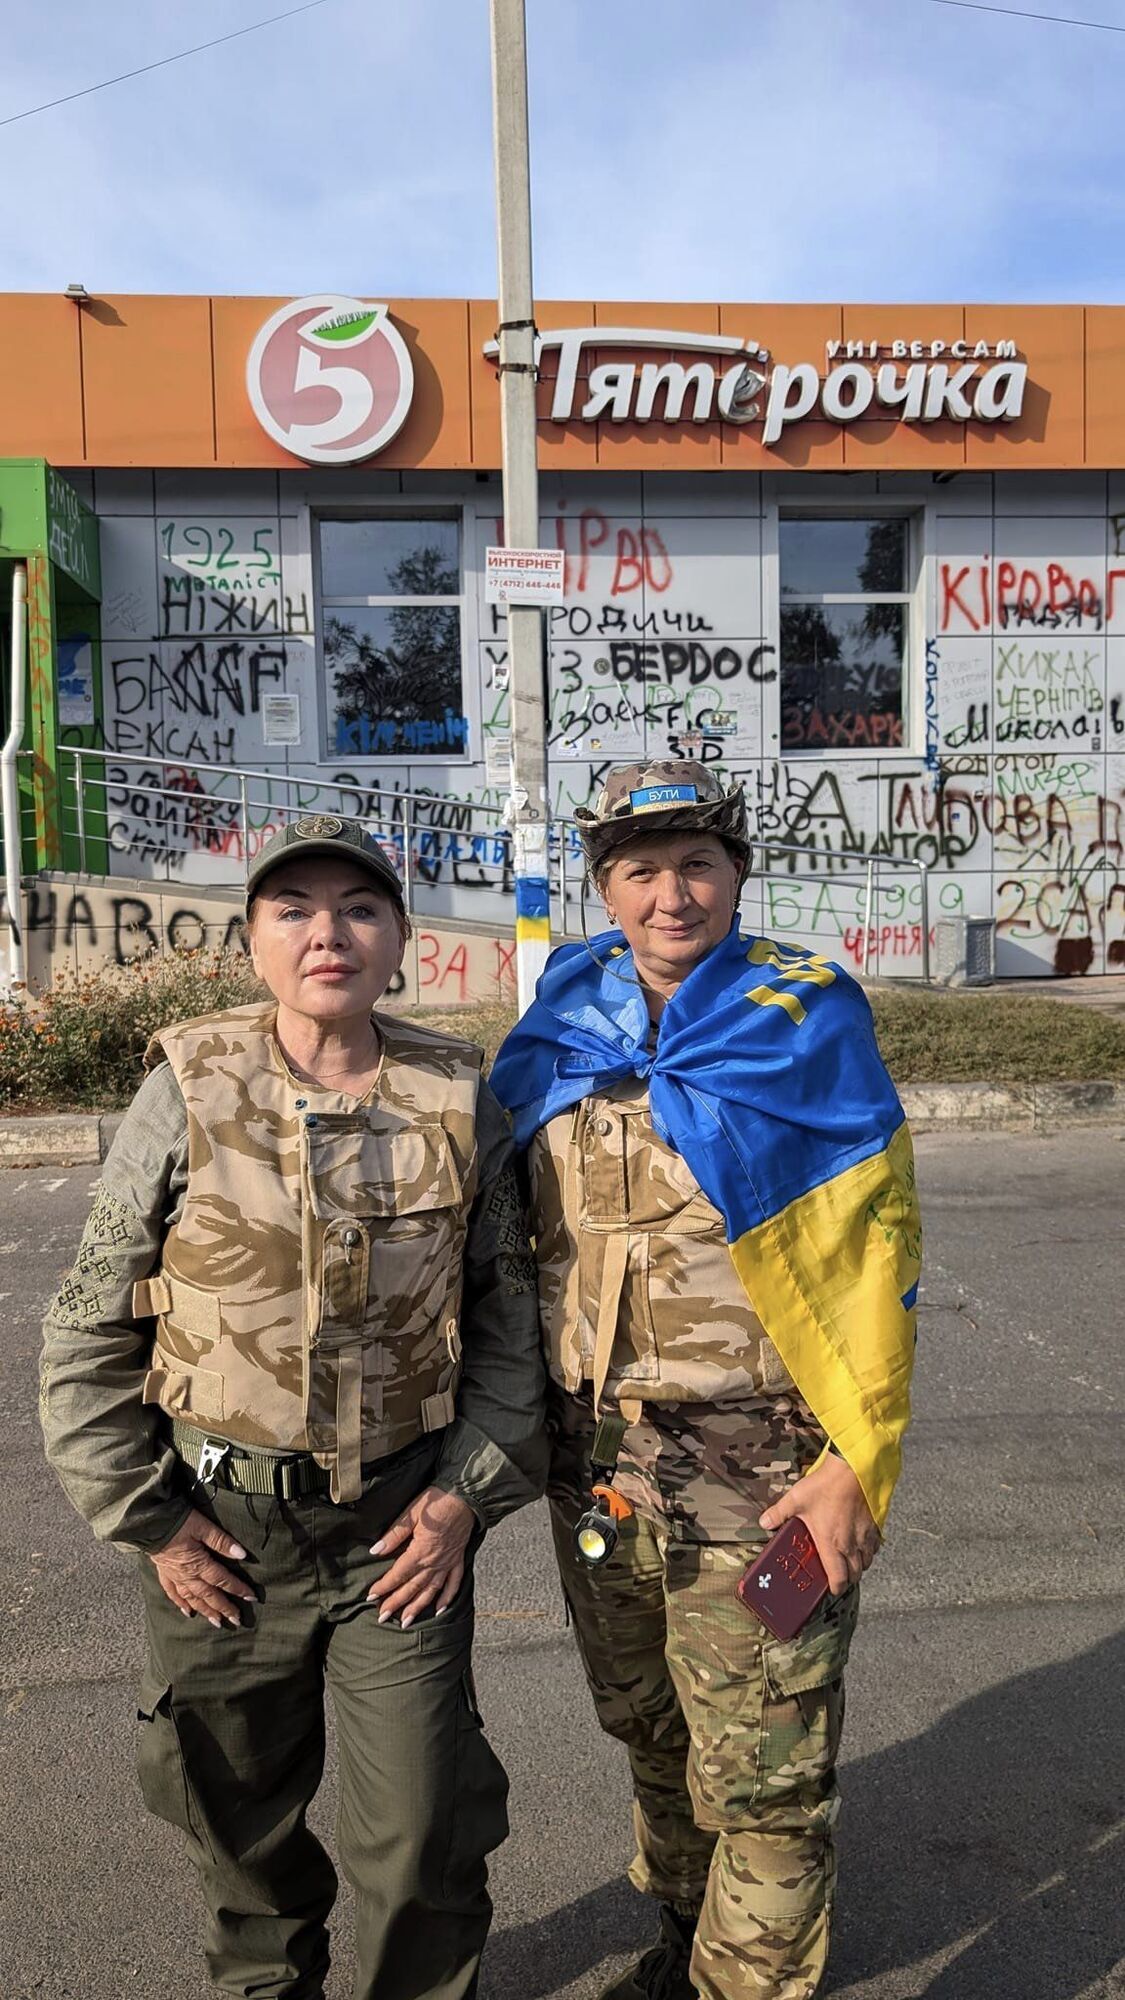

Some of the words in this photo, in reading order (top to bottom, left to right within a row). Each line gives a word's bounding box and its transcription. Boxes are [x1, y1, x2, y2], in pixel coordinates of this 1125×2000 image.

[161, 522, 273, 570] 1925
[488, 557, 561, 569] ИНТЕРНЕТ
[490, 603, 714, 636] НРОДИЧИ
[649, 789, 680, 801] БУТИ
